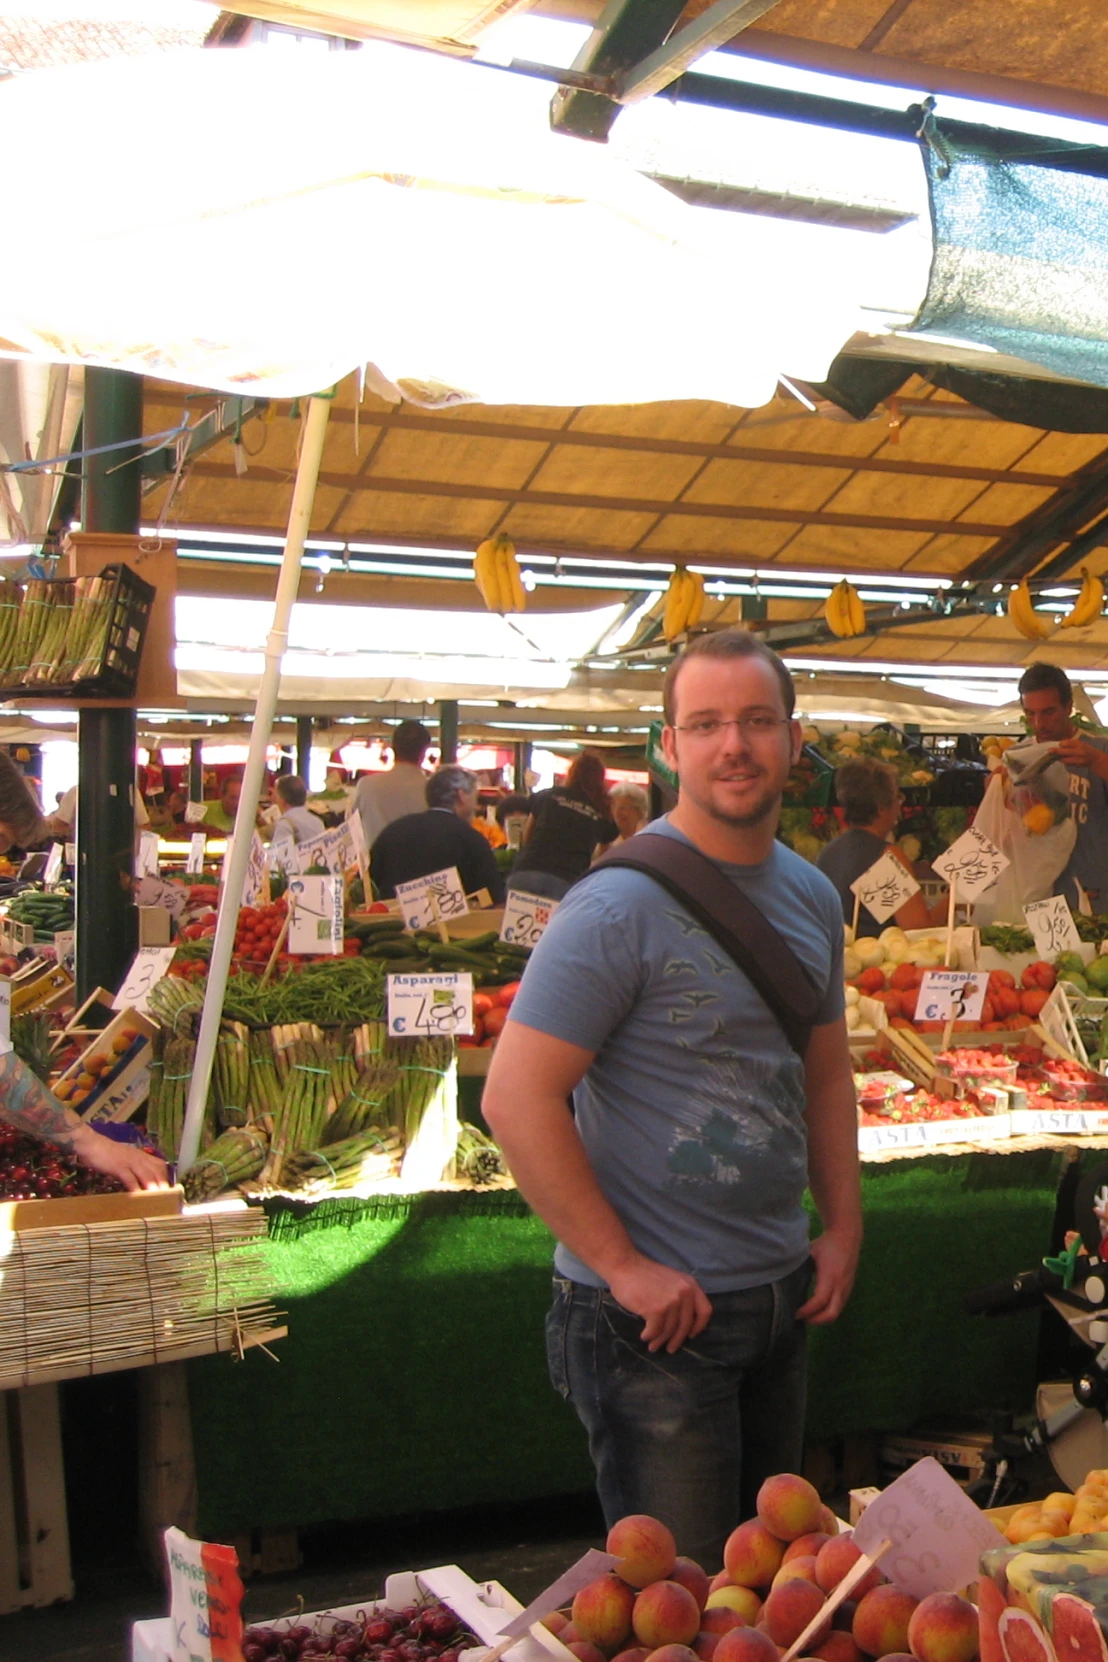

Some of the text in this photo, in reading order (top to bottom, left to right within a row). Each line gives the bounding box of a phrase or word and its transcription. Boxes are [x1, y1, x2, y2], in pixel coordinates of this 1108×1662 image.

[393, 974, 459, 988] Asparagi
[929, 971, 978, 983] Fragole
[925, 1003, 939, 1019] €
[392, 1017, 407, 1033] €
[1031, 1111, 1089, 1131] ASTA
[868, 1125, 928, 1147] ASTA
